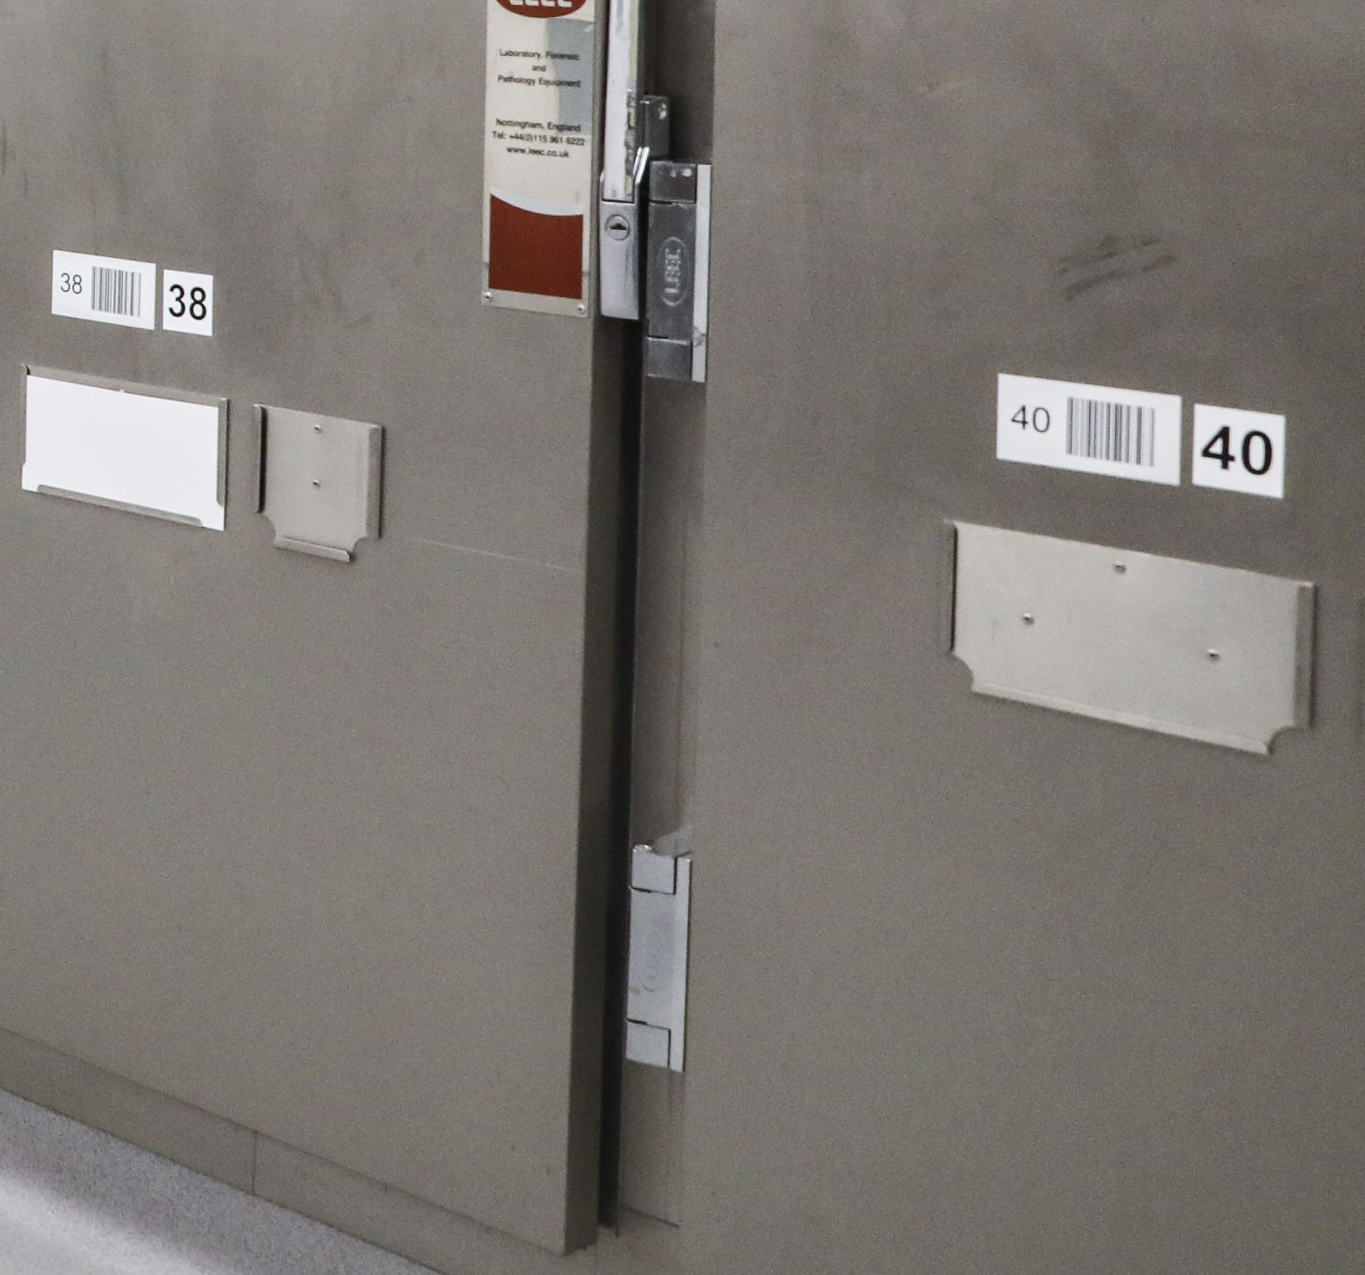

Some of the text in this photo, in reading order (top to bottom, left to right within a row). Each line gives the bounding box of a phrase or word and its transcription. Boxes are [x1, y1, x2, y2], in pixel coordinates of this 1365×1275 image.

[499, 49, 580, 61] Laboratory, Forensic
[532, 64, 547, 72] and
[497, 74, 581, 88] Pathology Equipment
[547, 121, 581, 133] England
[59, 271, 84, 296] 38
[167, 282, 208, 322] 38
[1009, 403, 1052, 434] 40
[1199, 424, 1274, 477] 40
